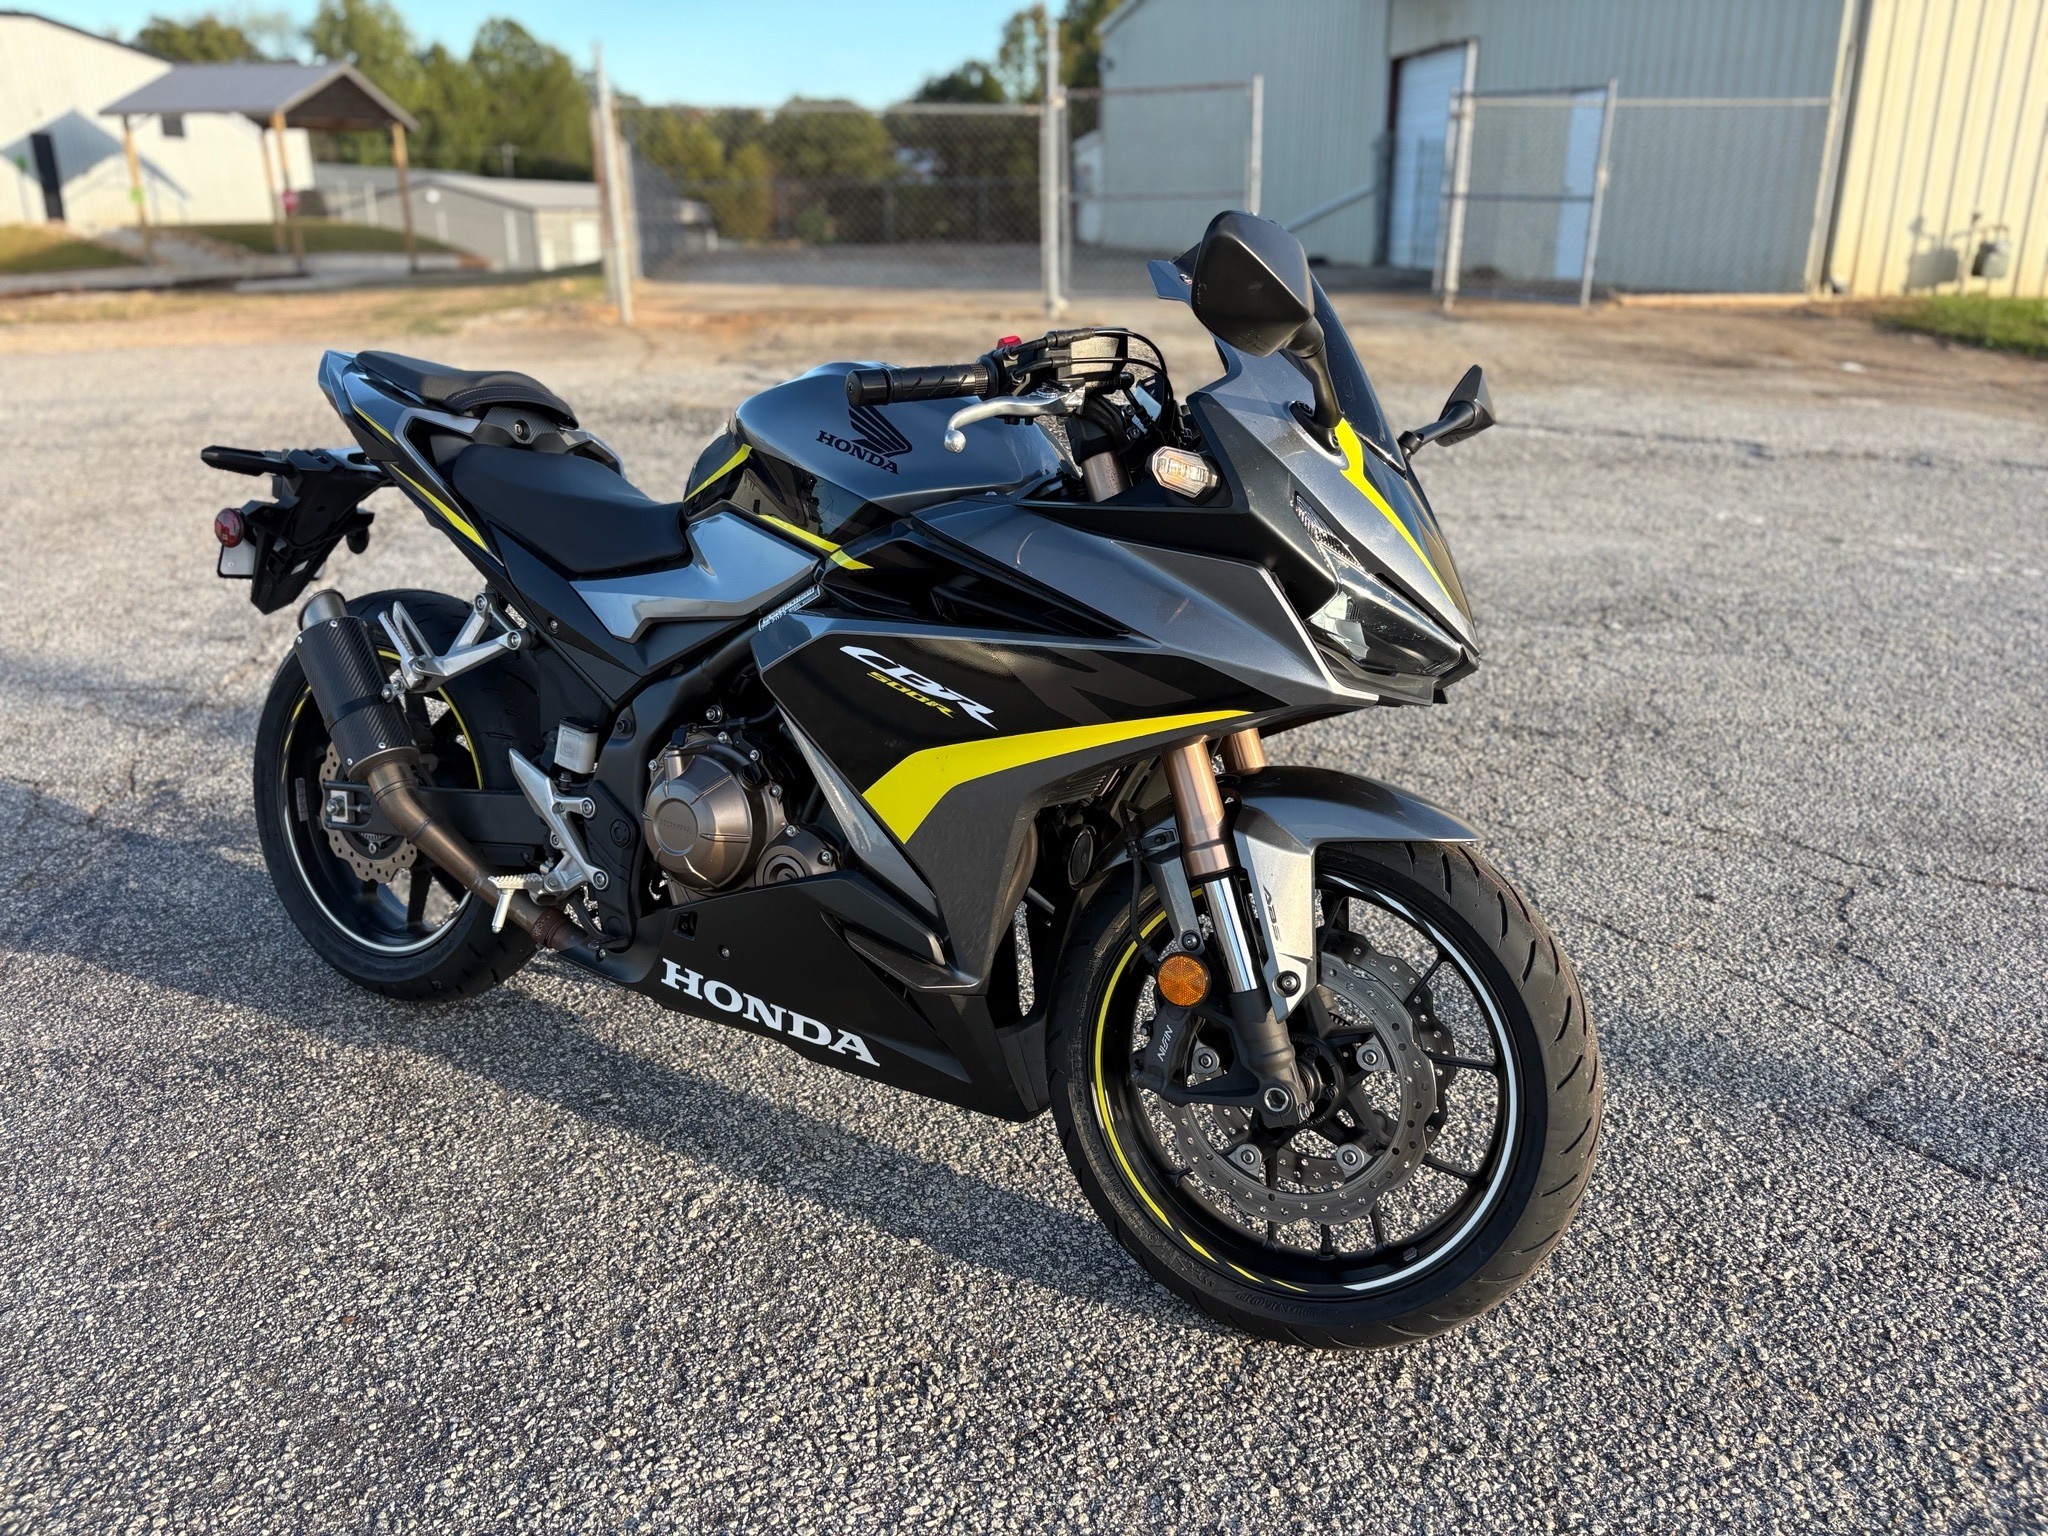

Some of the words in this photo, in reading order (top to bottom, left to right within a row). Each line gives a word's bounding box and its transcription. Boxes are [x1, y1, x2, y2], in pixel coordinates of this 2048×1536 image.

[816, 430, 899, 475] HONDA
[839, 645, 999, 731] CBR
[866, 671, 956, 719] 500R
[1263, 885, 1282, 942] ABS
[661, 957, 881, 1067] HONDA
[1157, 1024, 1173, 1062] NISSIN
